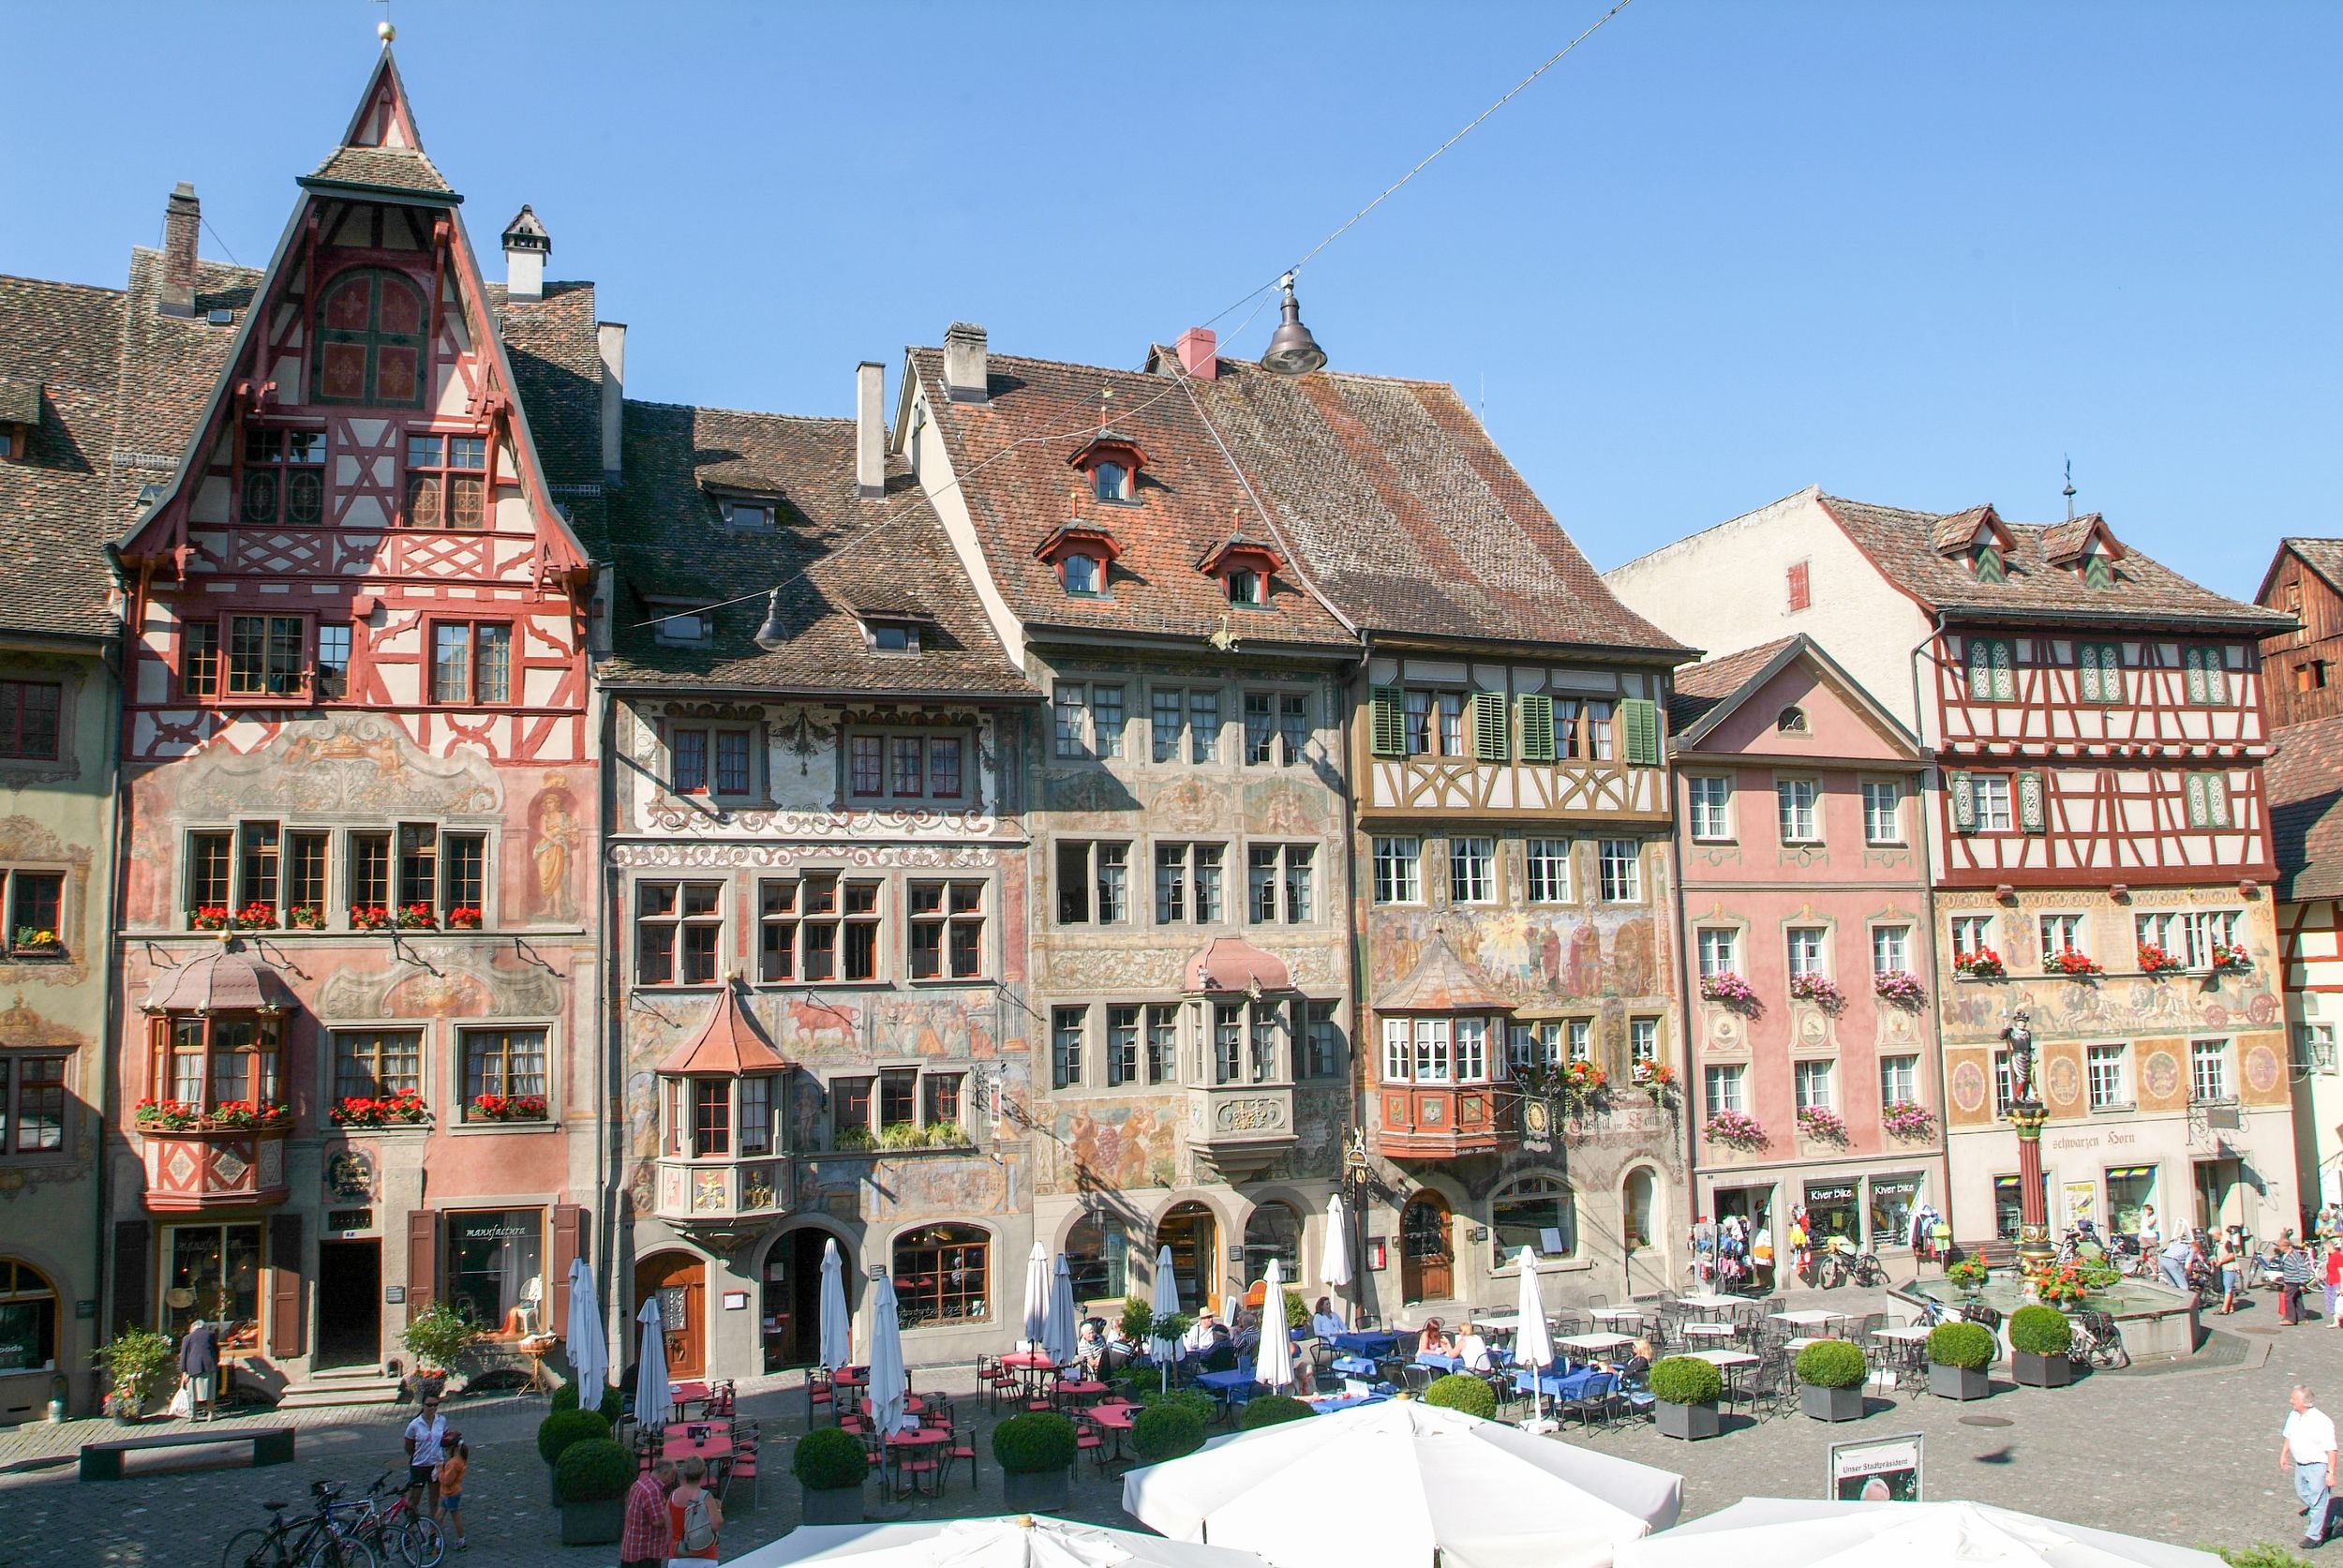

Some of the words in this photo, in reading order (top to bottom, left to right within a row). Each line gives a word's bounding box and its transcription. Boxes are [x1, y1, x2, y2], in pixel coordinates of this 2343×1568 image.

[1627, 1111, 1662, 1130] Sonn
[2052, 1136, 2099, 1150] schwarzen
[2108, 1130, 2135, 1144] Horn
[1811, 1189, 1833, 1201] River
[1834, 1187, 1852, 1198] Bike
[1874, 1185, 1896, 1195] River
[1897, 1183, 1914, 1192] Bike
[466, 1223, 526, 1241] manufactura
[1250, 1293, 1264, 1303] BEC
[1843, 1464, 1861, 1474] Unser
[1863, 1458, 1908, 1471] Stadtpräsident
